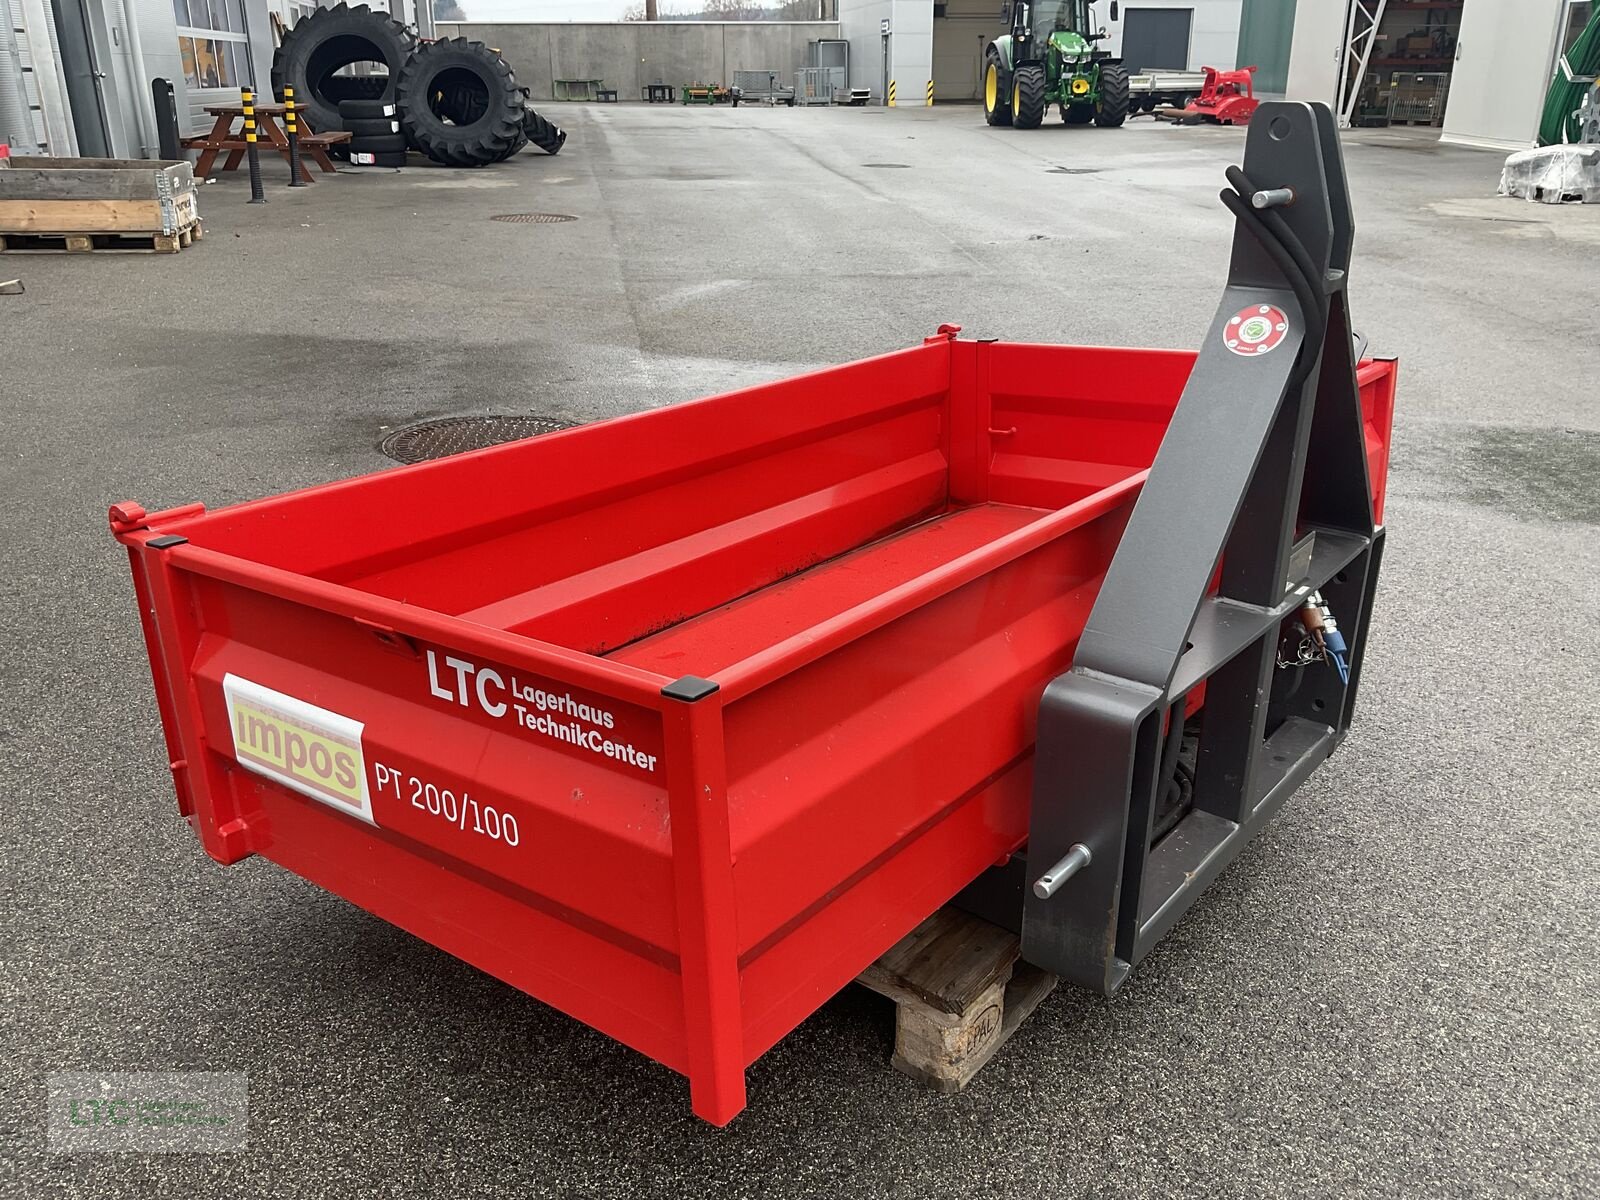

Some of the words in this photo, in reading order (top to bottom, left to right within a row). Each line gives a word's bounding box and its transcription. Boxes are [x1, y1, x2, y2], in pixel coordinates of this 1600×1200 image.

[427, 650, 507, 718] LTC
[512, 677, 614, 729] Lagerhaus
[237, 711, 357, 790] impos
[514, 704, 657, 772] TechnikCenter
[375, 762, 402, 799] PT
[409, 777, 519, 847] 200/100
